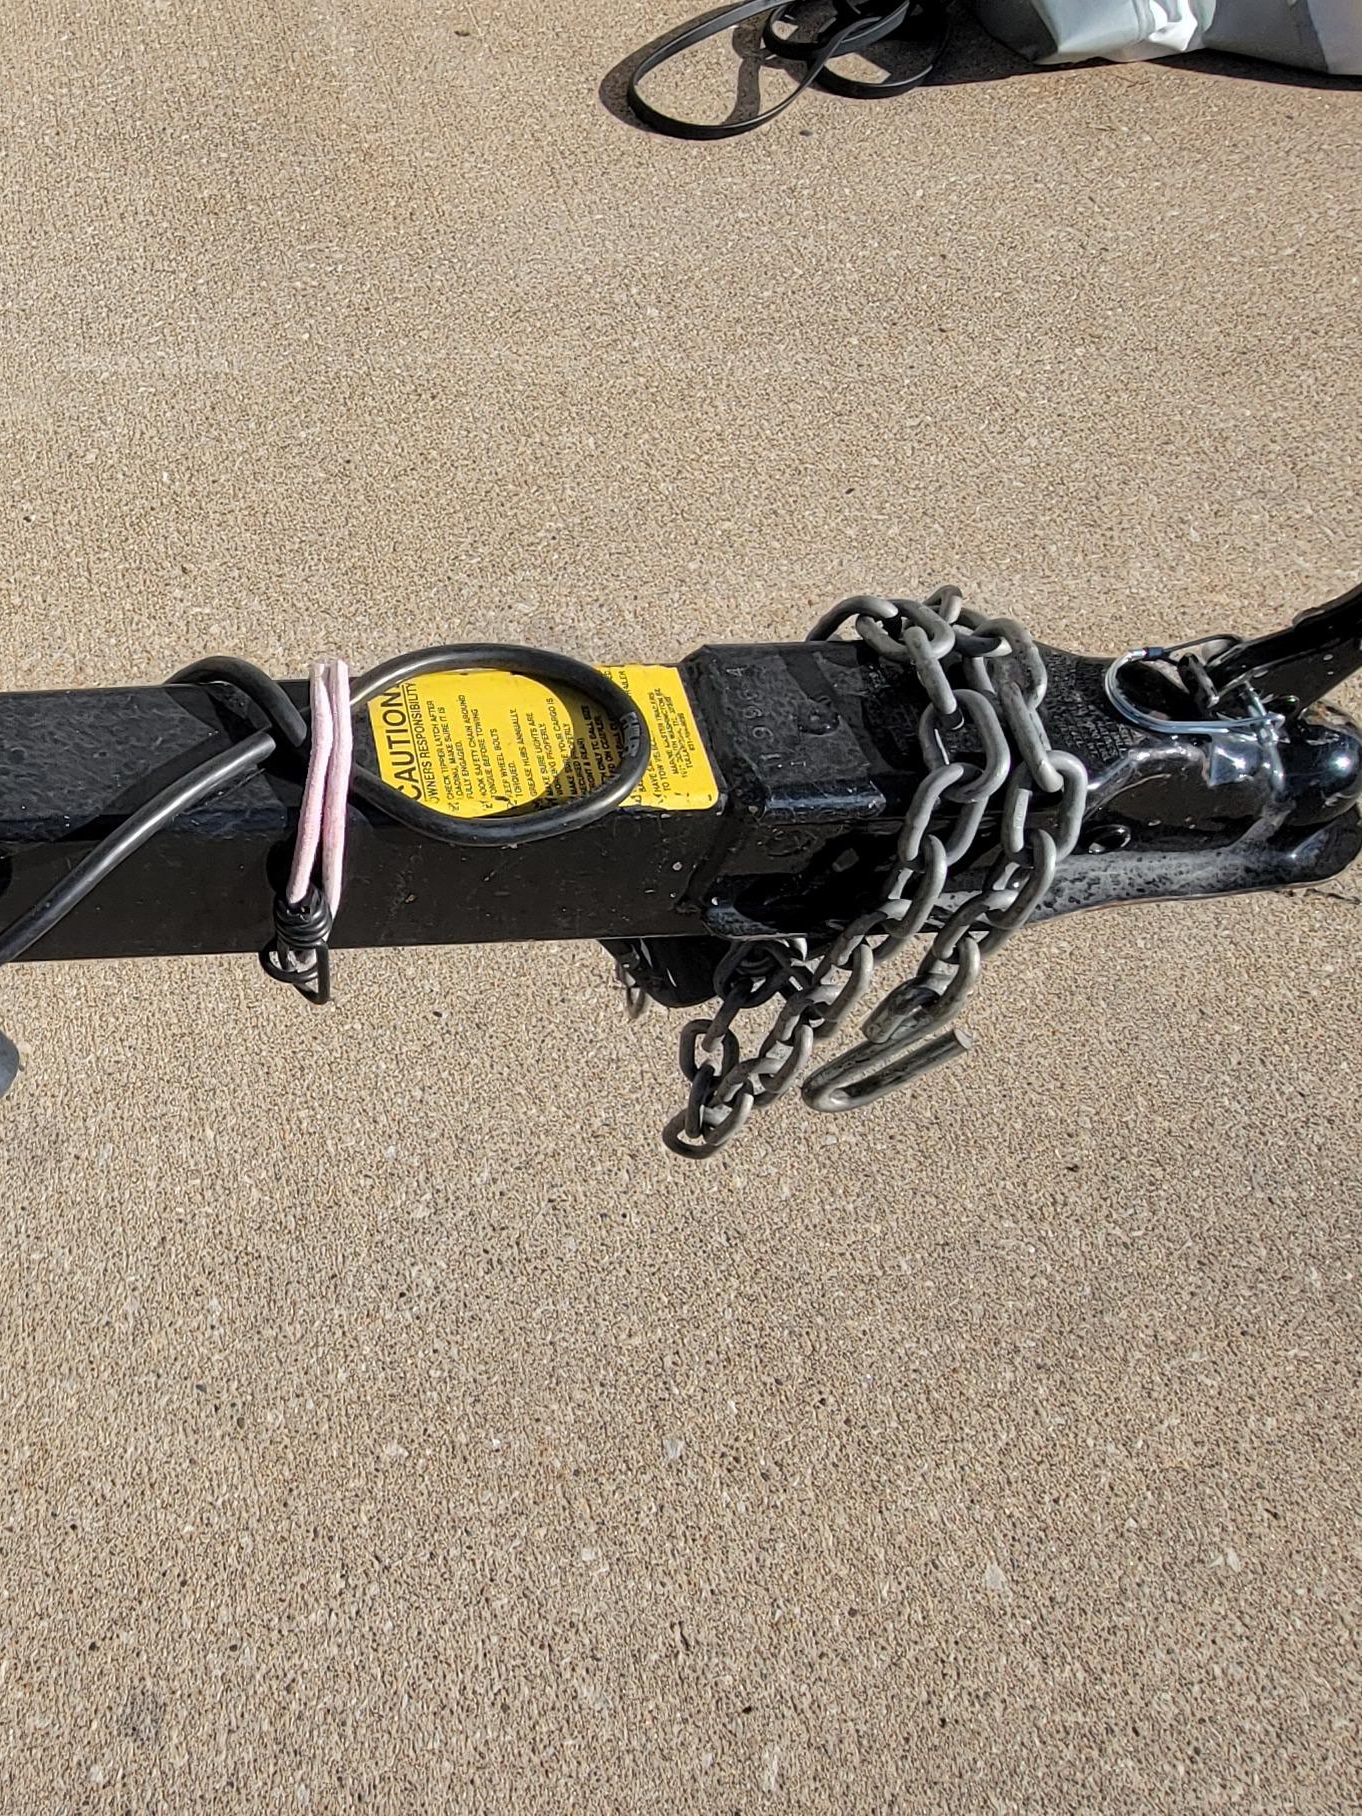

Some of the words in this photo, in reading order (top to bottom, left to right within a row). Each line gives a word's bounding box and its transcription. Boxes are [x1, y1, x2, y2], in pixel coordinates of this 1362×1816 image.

[405, 682, 430, 758] RESPONSIBILITY
[426, 700, 438, 722] AFTER
[458, 694, 470, 724] AROUND
[432, 724, 444, 746] LATCH
[441, 723, 452, 742] SURE
[465, 725, 477, 747] CHAIN
[437, 748, 449, 773] TIPPER
[445, 744, 457, 764] MAKE
[470, 749, 483, 775] SAFETY
[478, 738, 491, 767] BEFORE
[421, 761, 439, 803] OWNERS
[443, 775, 454, 800] CHECK
